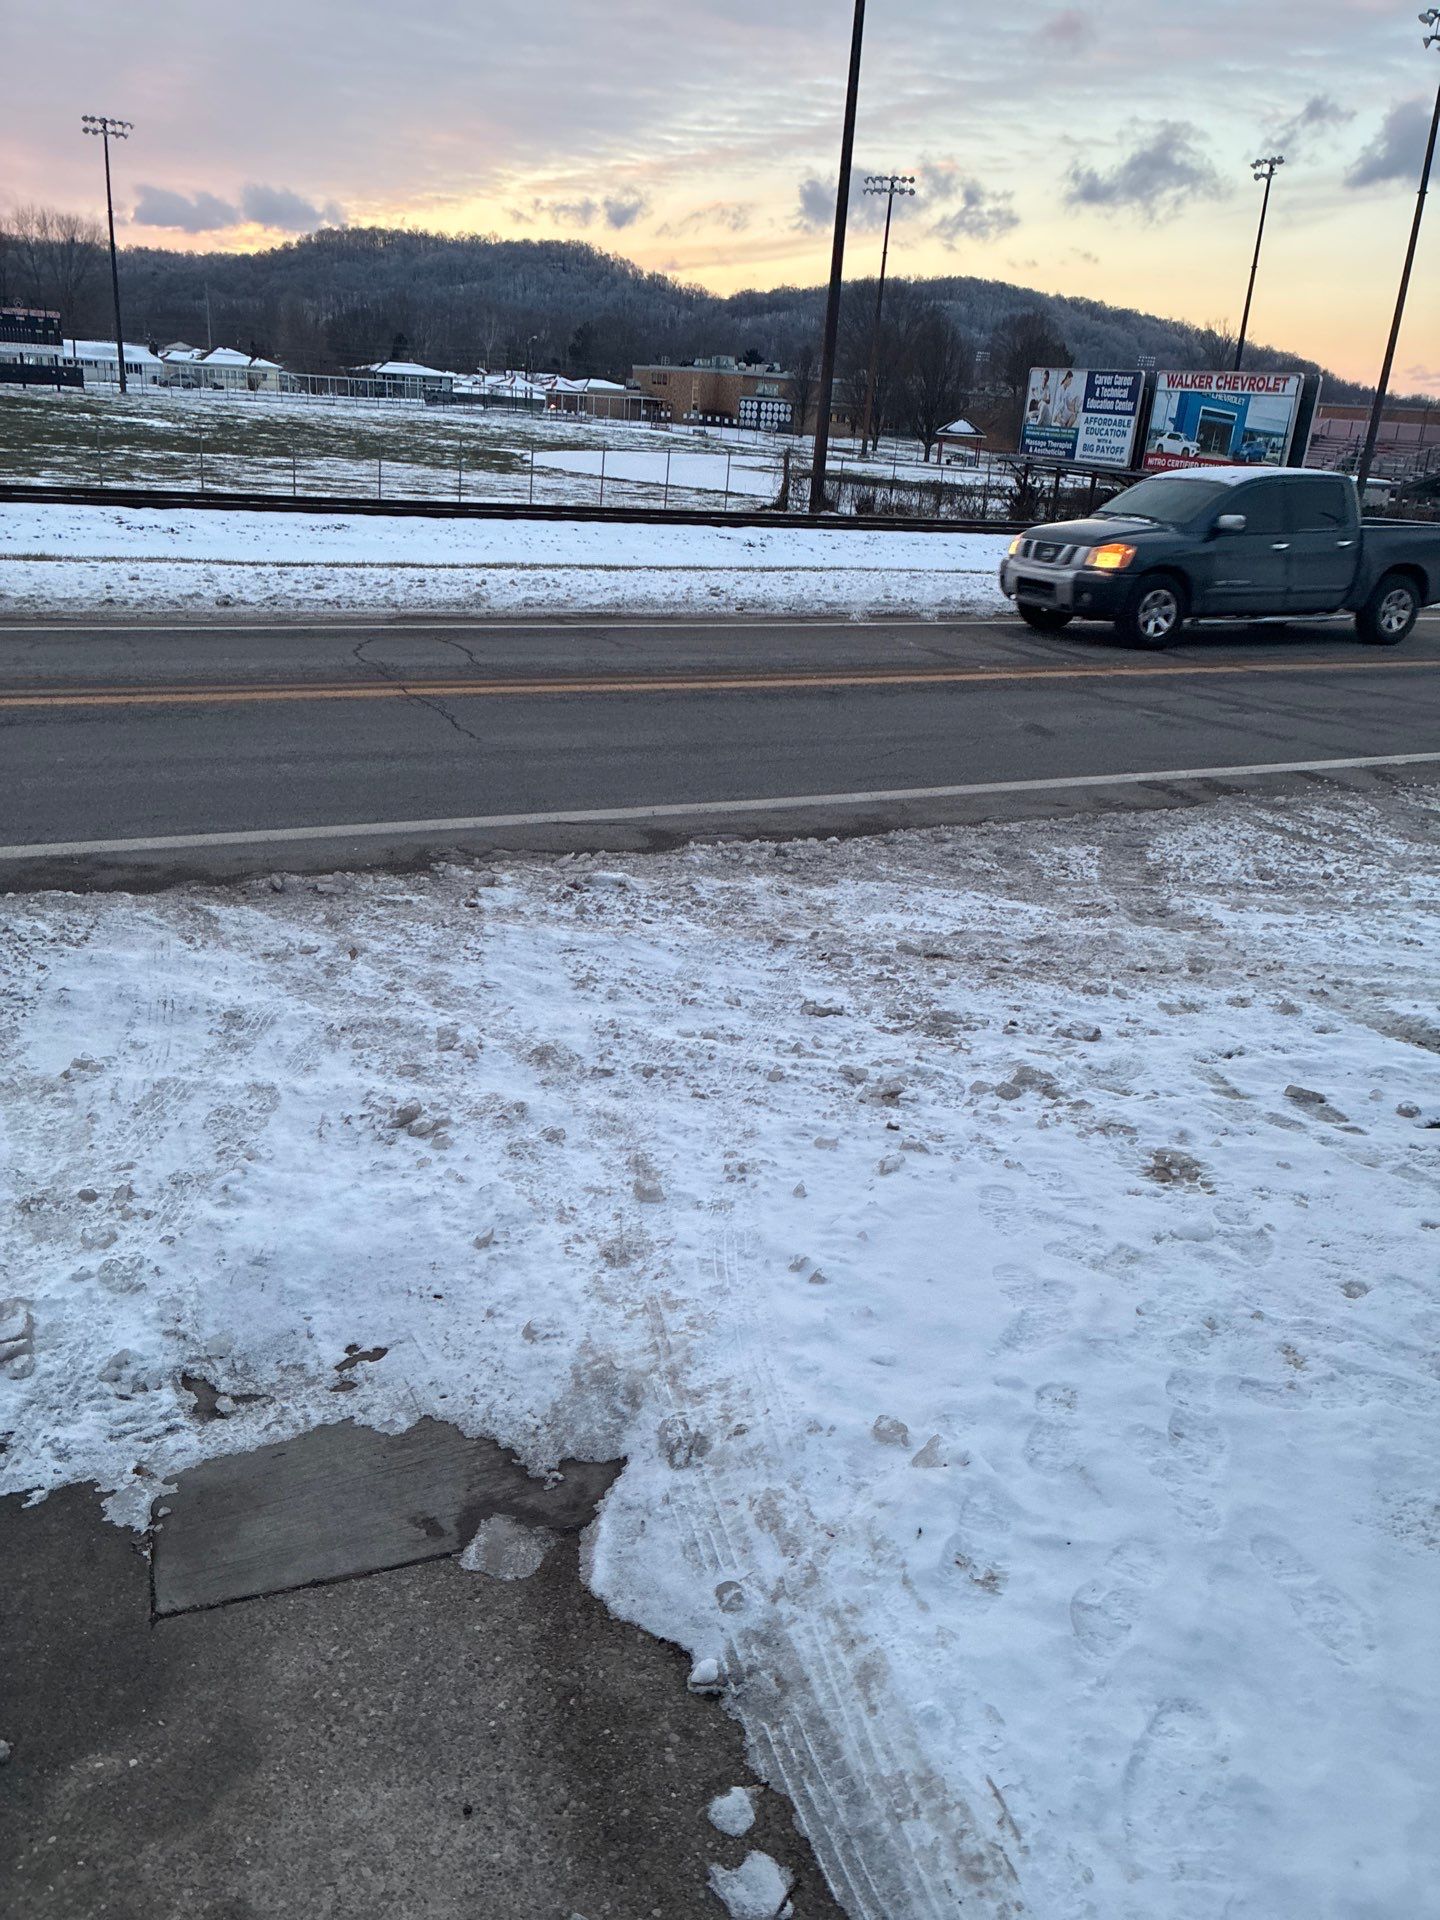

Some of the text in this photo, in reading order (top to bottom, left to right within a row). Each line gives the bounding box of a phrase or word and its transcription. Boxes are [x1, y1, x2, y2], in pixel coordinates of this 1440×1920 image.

[1095, 374, 1133, 385] Carver Career
[1167, 374, 1289, 392] WALKER CHEVROLET
[1101, 386, 1129, 398] Technical
[1086, 397, 1134, 411] Education Center
[1212, 393, 1245, 405] CHEVROLET
[1084, 416, 1132, 428] AFFORDABLE
[1085, 426, 1127, 438] EDUCATION
[1025, 438, 1072, 449] Massage Therapist
[1082, 443, 1125, 455] BIG PAYOFF
[1147, 457, 1166, 467] NITRO
[1167, 459, 1200, 468] CERTIFIED
